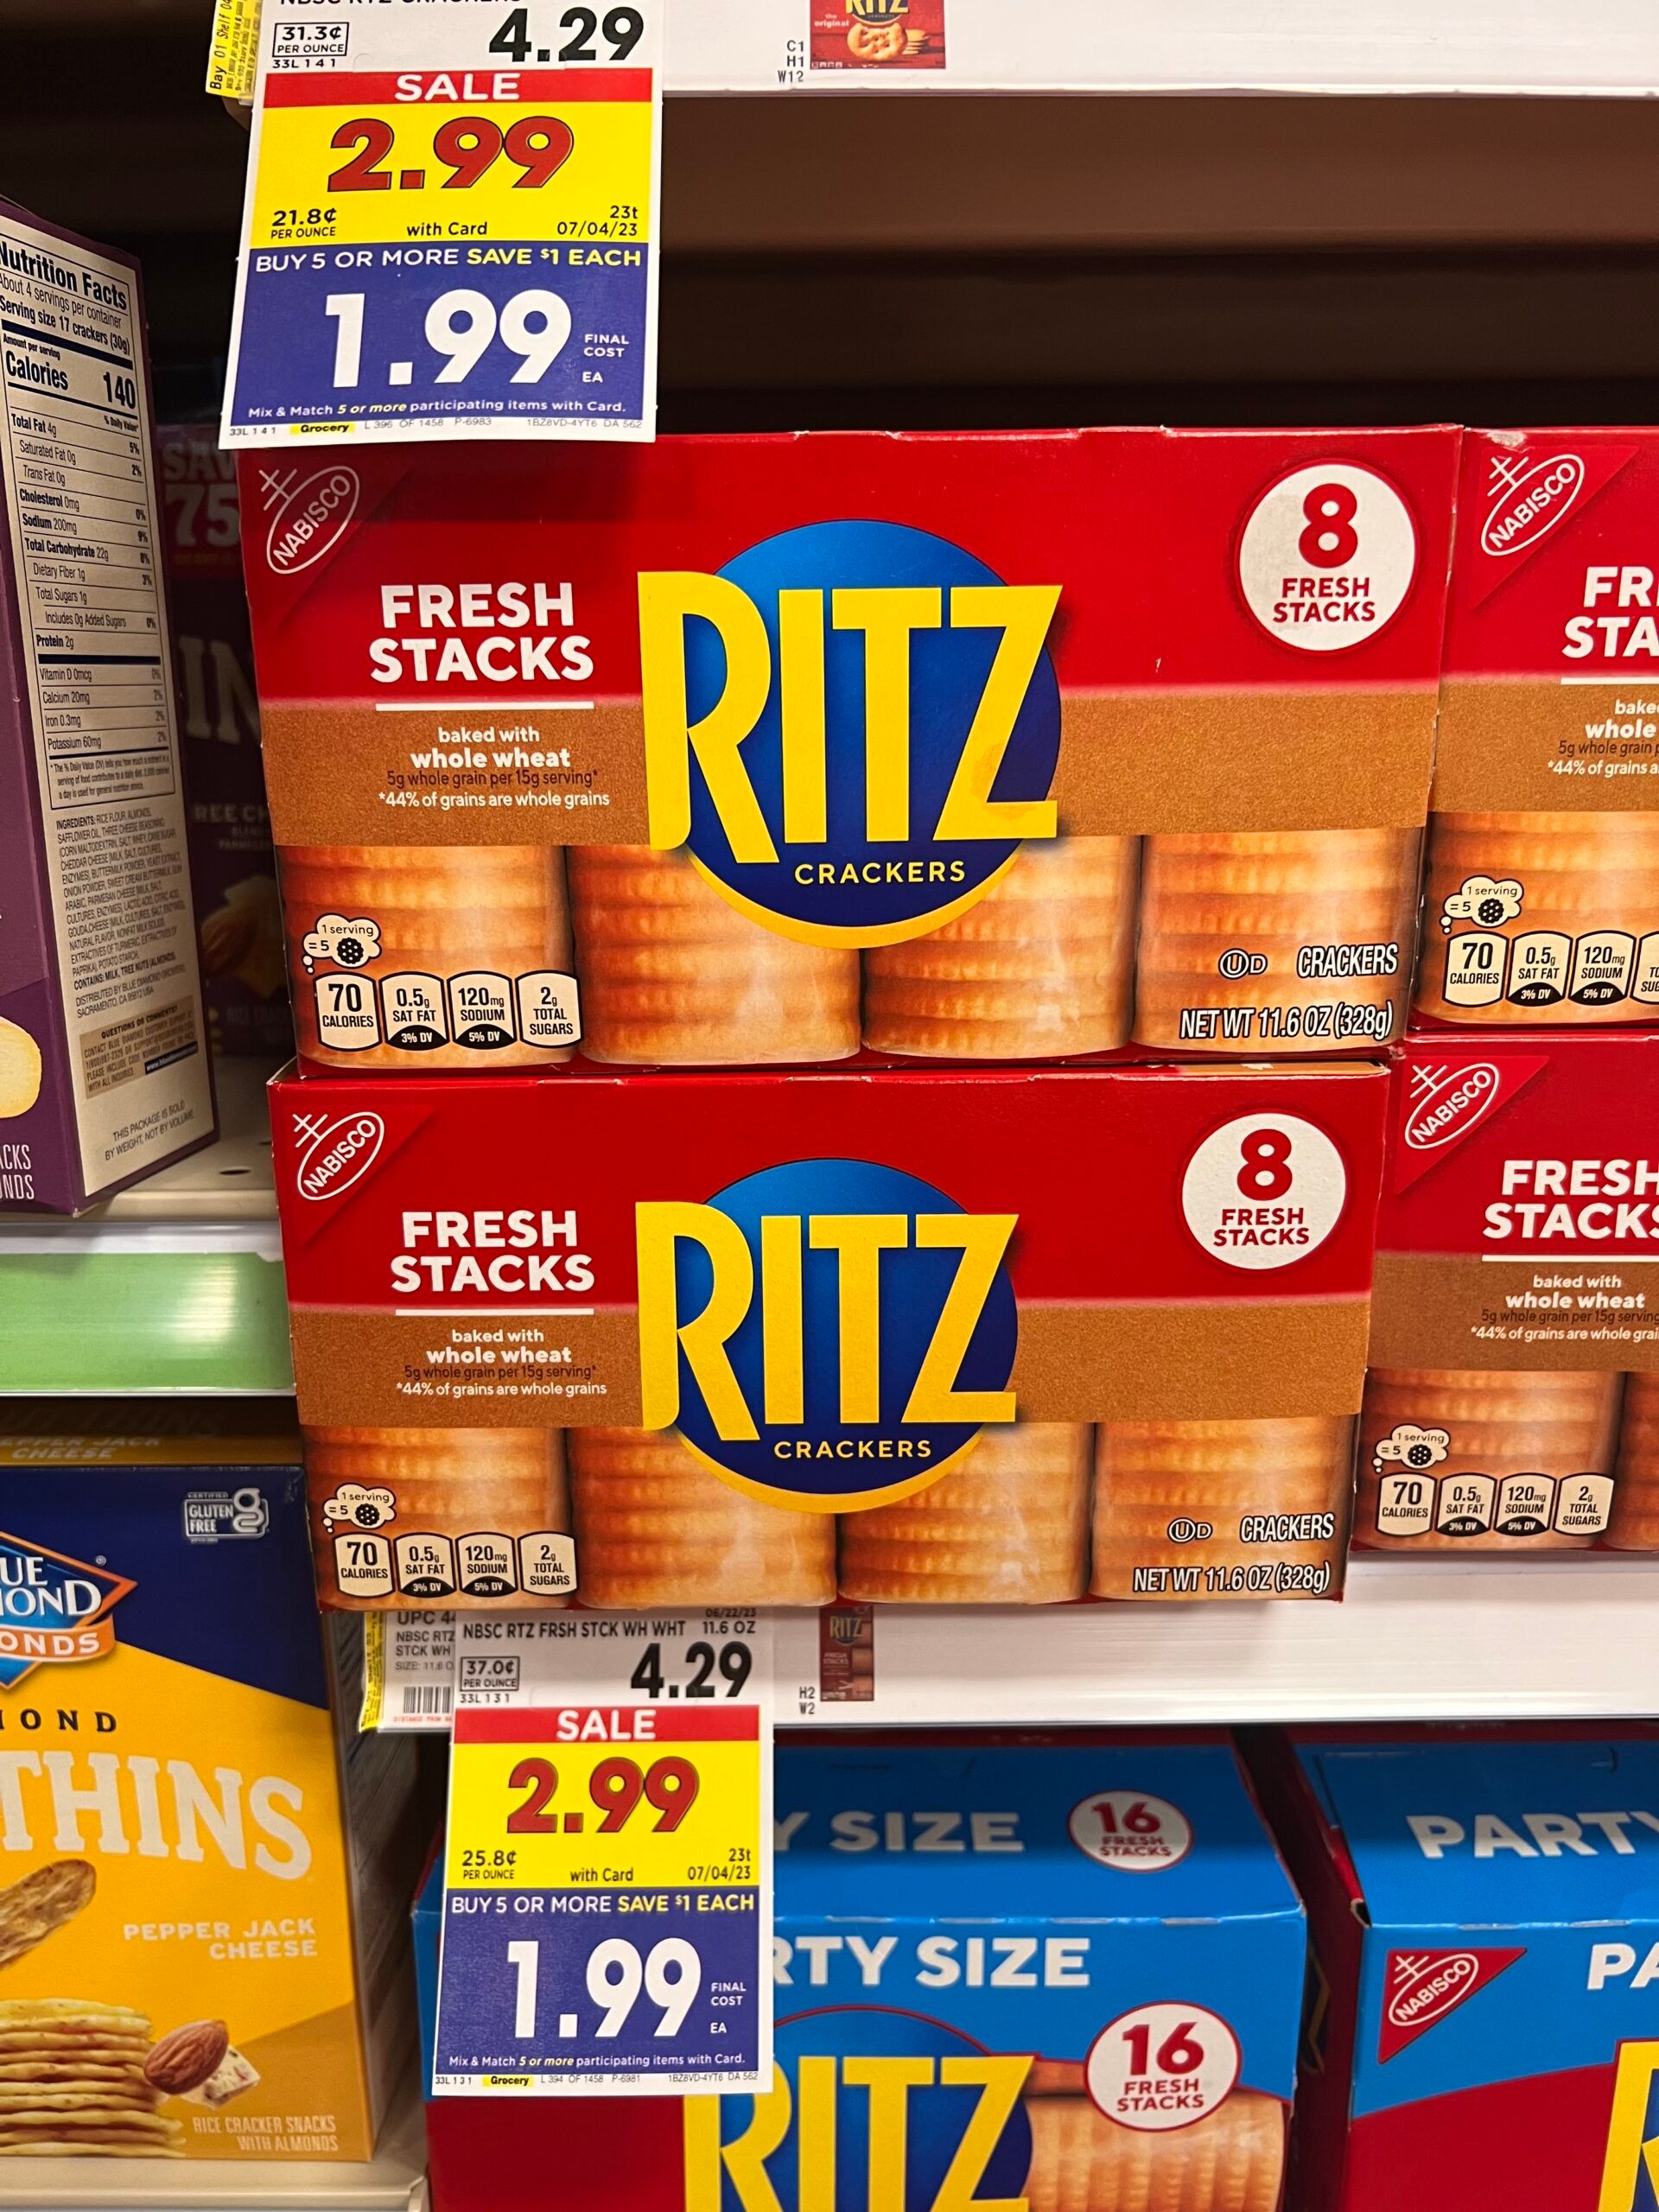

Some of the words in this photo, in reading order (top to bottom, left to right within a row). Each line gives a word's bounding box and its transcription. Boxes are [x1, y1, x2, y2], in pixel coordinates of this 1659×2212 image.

[217, 13, 231, 39] Shelf
[283, 26, 342, 41] 31.3¢
[488, 7, 645, 62] 4.29
[214, 45, 226, 58] 01
[277, 45, 299, 54] PER
[303, 44, 344, 53] OUNCE
[786, 41, 804, 52] C1
[273, 60, 299, 68] 33L
[315, 59, 325, 67] 4
[786, 56, 804, 67] H1
[209, 67, 227, 90] Bay
[394, 72, 521, 101] SALE
[778, 71, 804, 83] W12
[327, 116, 575, 193] 2.99
[271, 208, 338, 226] 21.8¢
[609, 206, 639, 219] 23t
[270, 229, 291, 238] PER
[295, 227, 336, 238] OUNCE
[407, 224, 442, 236] with
[448, 222, 487, 236] Card
[556, 222, 638, 237] 07/04/23
[255, 254, 307, 272] BUY
[312, 254, 327, 270] 5
[334, 252, 372, 267] OR
[382, 250, 459, 266] MORE
[466, 249, 532, 265] SAVE
[540, 249, 560, 265] $1
[569, 249, 641, 266] EACH
[0, 241, 78, 292] Nutrition
[82, 272, 127, 310] Facts
[26, 282, 32, 297] 4
[35, 288, 70, 312] servings
[72, 302, 85, 316] per
[86, 307, 121, 329] container
[0, 295, 35, 325] Serving
[38, 309, 56, 327] size
[60, 316, 69, 332] 17
[73, 322, 108, 345] crackers
[111, 333, 130, 356] (30g)
[325, 289, 572, 389] 1.99
[584, 334, 629, 345] FINAL
[583, 346, 625, 358] COST
[6, 350, 68, 390] Calories
[582, 372, 603, 383] EA
[105, 372, 137, 409] 140
[248, 407, 274, 417] Mix
[276, 406, 287, 416] &
[290, 404, 333, 416] Match
[337, 404, 347, 415] 5
[370, 404, 407, 413] more
[410, 401, 503, 415] participating
[508, 400, 548, 412] items
[552, 401, 583, 412] with
[588, 400, 626, 412] Card.
[11, 413, 31, 429] Total
[34, 418, 46, 433] Fat
[48, 423, 57, 438] 4g
[300, 423, 349, 435] Grocery
[1488, 462, 1576, 549] NABISCO
[22, 513, 52, 529] Sodium
[54, 518, 77, 535] 200mg
[273, 474, 351, 566] NABISCO
[1298, 482, 1359, 569] 8
[1281, 577, 1371, 600] FRESH
[380, 582, 574, 629] FRESH
[1272, 600, 1376, 624] STACKS
[369, 635, 594, 683] STACKS
[637, 571, 1064, 865] RITZ
[438, 727, 495, 743] baked
[499, 727, 540, 742] with
[410, 749, 487, 768] whole
[493, 748, 570, 767] wheat
[387, 772, 404, 788] 5g
[407, 771, 448, 786] whole
[452, 771, 487, 788] grain
[490, 773, 512, 788] per
[515, 770, 540, 787] 15g
[423, 791, 438, 807] of
[440, 791, 486, 810] grains
[489, 795, 512, 805] are
[515, 791, 562, 806] whole
[564, 791, 610, 809] grains
[794, 862, 966, 886] CRACKERS
[321, 924, 327, 934] 1
[330, 925, 373, 938] serving
[1297, 943, 1399, 978] CRACKERS
[328, 983, 362, 1013] 70
[397, 988, 430, 1009] 0.5g
[458, 988, 505, 1008] 120mg
[541, 987, 558, 1006] 2g
[322, 1015, 373, 1028] CALORIES
[392, 1010, 413, 1022] SAT
[417, 1009, 436, 1021] FAT
[460, 1009, 505, 1021] SODIUM
[534, 1008, 567, 1020] TOTAL
[1179, 1009, 1219, 1040] NET
[1222, 1007, 1256, 1038] WT
[1257, 1007, 1303, 1038] 11.6
[1302, 1003, 1335, 1037] OZ
[1333, 1000, 1394, 1042] (328g)
[529, 1023, 573, 1035] SUGARS
[1411, 1070, 1491, 1143] NABISCO
[302, 1119, 377, 1194] NABISCO
[1236, 1128, 1294, 1202] 8
[1502, 1160, 1659, 1196] FRESH
[402, 1210, 577, 1249] FRESH
[390, 1254, 595, 1293] STACKS
[634, 1202, 1019, 1441] RITZ
[773, 1439, 932, 1459] CRACKERS
[188, 1504, 235, 1519] GLUTEN
[189, 1519, 217, 1534] FREE
[463, 1623, 502, 1639] NBSC
[506, 1623, 535, 1638] RTZ
[538, 1622, 577, 1637] FRSH
[581, 1621, 619, 1637] STCK
[622, 1621, 650, 1637] WH
[652, 1620, 686, 1637] WHT
[702, 1621, 728, 1634] 11.6
[734, 1621, 756, 1633] OZ
[467, 1661, 514, 1675] 37.0¢
[631, 1641, 753, 1699] 4.29
[799, 1687, 816, 1699] H2
[799, 1702, 815, 1714] W2
[556, 1709, 657, 1741] SALE
[506, 1756, 700, 1834] 2.99
[0, 1751, 312, 1880] THINS
[462, 1849, 517, 1867] 25.8¢
[688, 1866, 751, 1881] 07/04/23
[124, 1922, 231, 1941] PEPPER
[244, 1918, 316, 1938] JACK
[210, 1940, 318, 1961] CHEESE
[915, 1936, 1090, 1988] SIZE
[508, 1937, 702, 2038] 1.99
[1395, 1959, 1471, 2021] NABISCO
[1122, 2021, 1205, 2076] 16
[1124, 2077, 1200, 2095] FRESH
[1116, 2093, 1204, 2113] STACKS
[194, 2117, 223, 2135] RICE
[226, 2116, 283, 2134] CRACKER
[286, 2114, 335, 2133] SNACKS
[684, 2056, 1035, 2212] RITZ
[238, 2134, 273, 2152] WITH
[276, 2134, 339, 2152] ALMONDS
